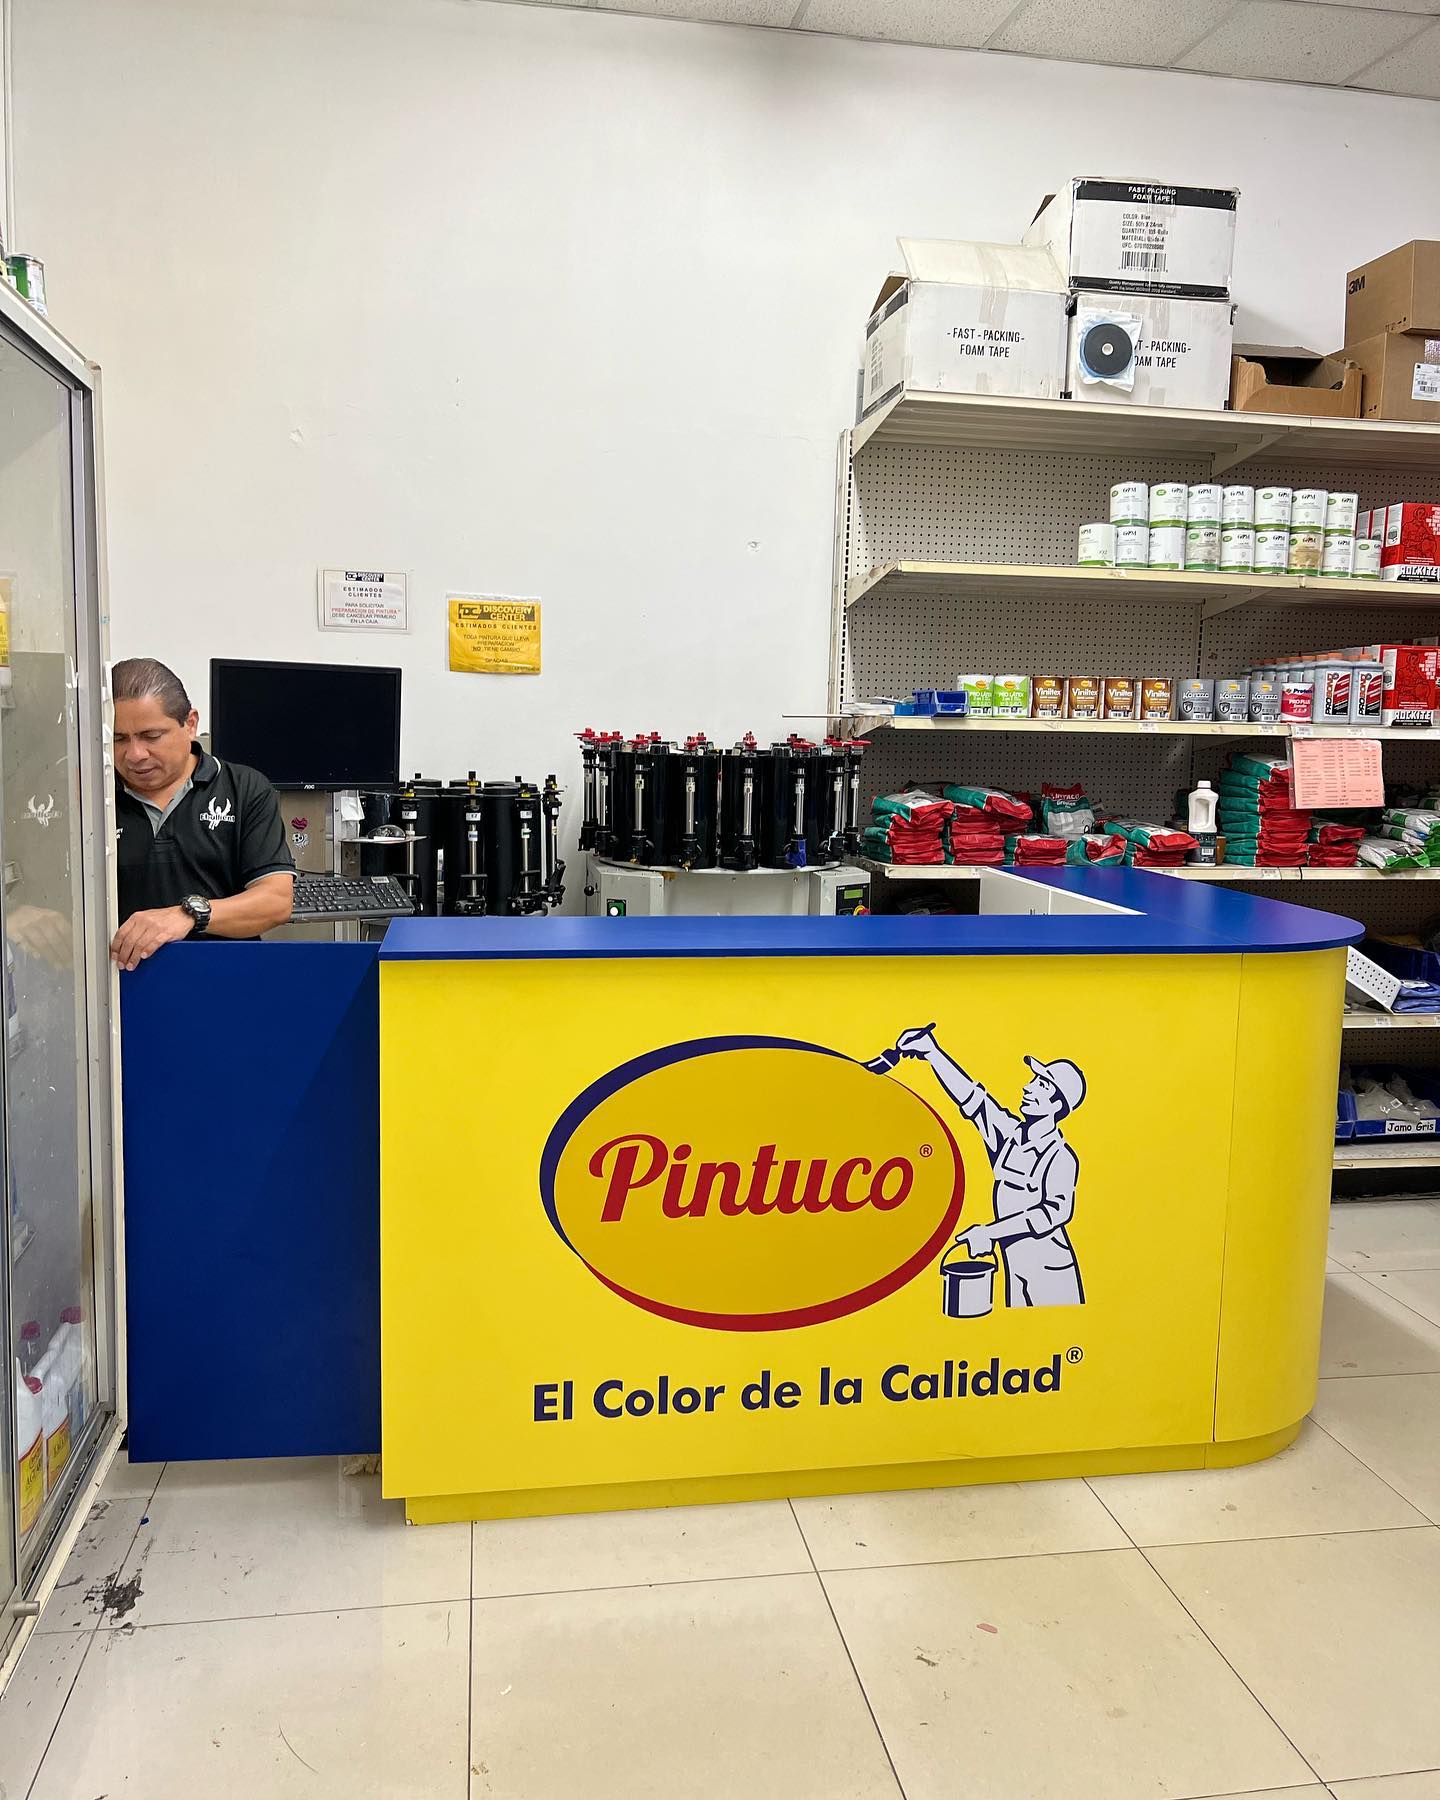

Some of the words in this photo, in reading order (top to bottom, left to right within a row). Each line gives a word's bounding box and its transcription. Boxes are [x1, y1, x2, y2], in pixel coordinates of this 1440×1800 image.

[1147, 187, 1177, 195] PACKING
[1348, 276, 1366, 294] 3M
[960, 344, 984, 357] FOAM
[989, 346, 1010, 358] TAPE
[1156, 357, 1176, 368] TAPE
[1401, 566, 1438, 575] ROCKITE
[483, 606, 532, 614] DISCOVERY
[1036, 688, 1061, 696] Viniltex
[1394, 711, 1431, 720] ROCKITE
[1388, 1123, 1412, 1132] Jamo
[1416, 1122, 1434, 1131] Gris
[589, 1134, 914, 1223] Pintuco
[534, 1381, 573, 1422] El
[593, 1376, 725, 1420] Color
[741, 1370, 802, 1411] de
[820, 1367, 862, 1406] la
[880, 1354, 1062, 1400] Calidad
